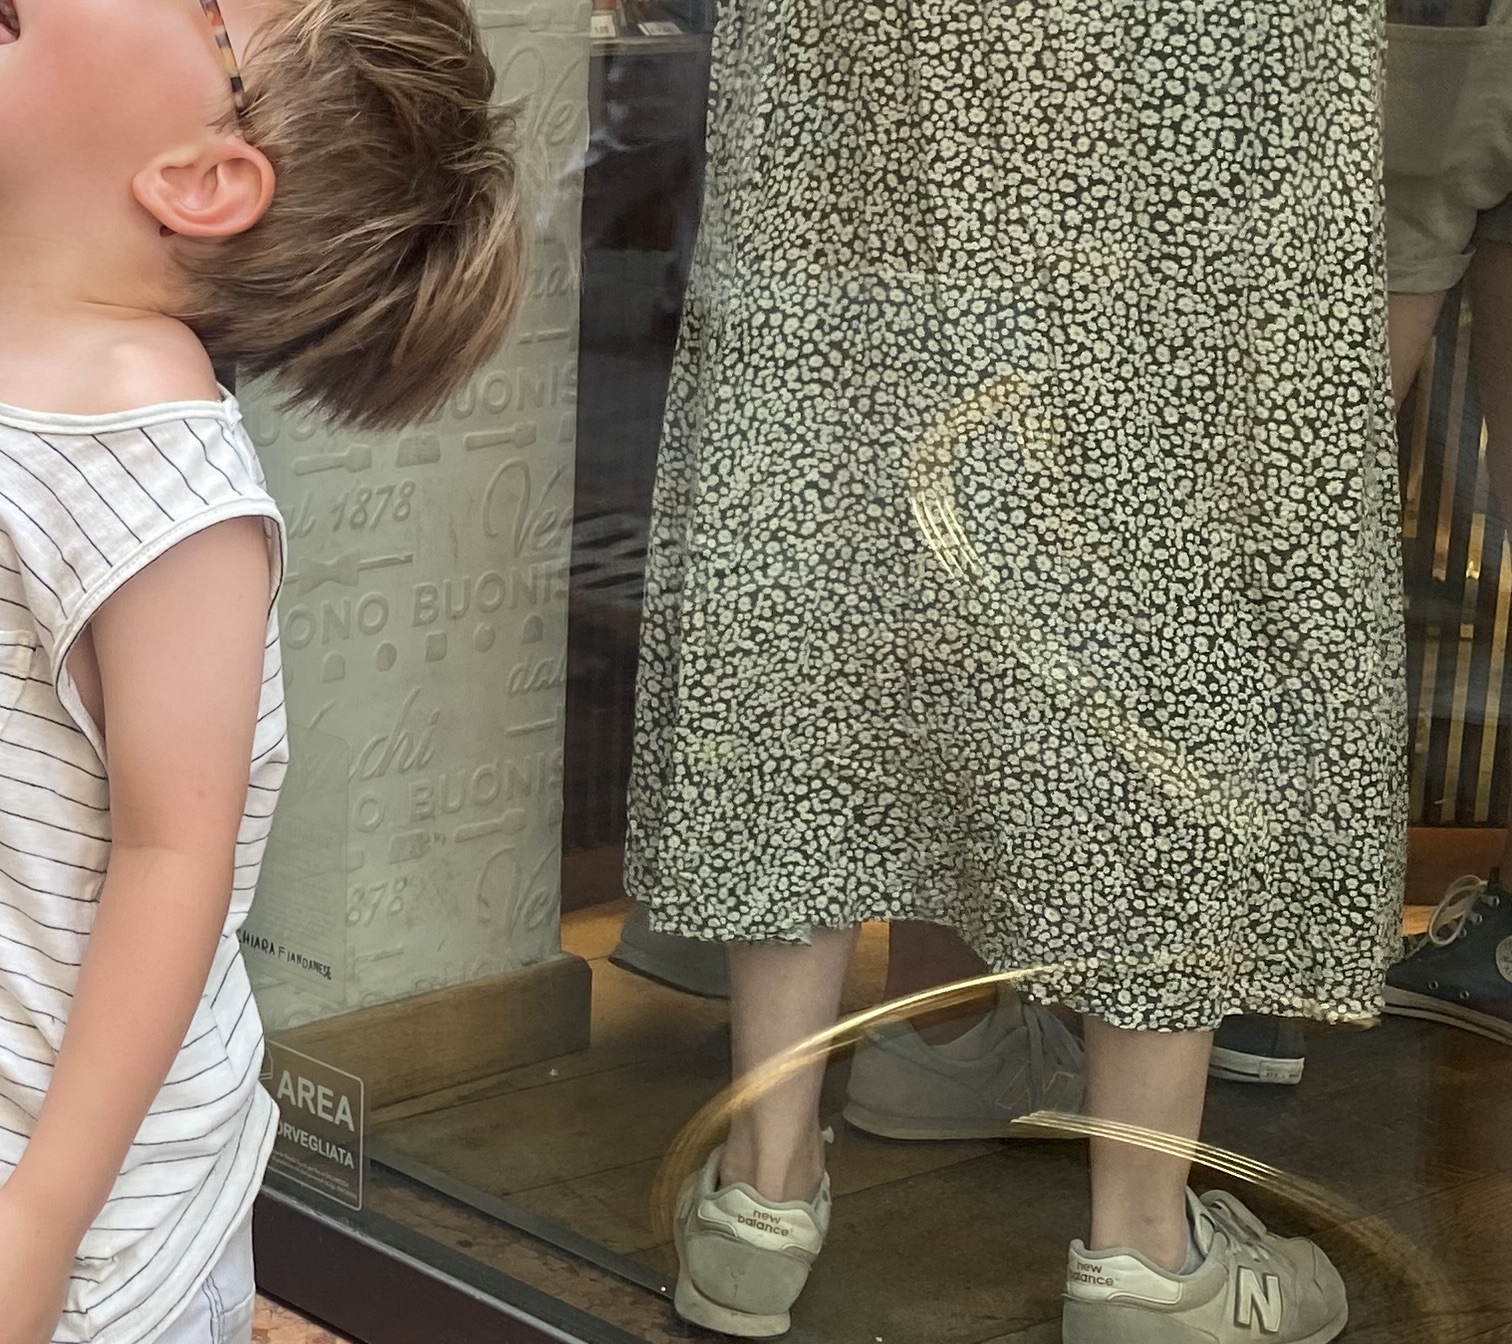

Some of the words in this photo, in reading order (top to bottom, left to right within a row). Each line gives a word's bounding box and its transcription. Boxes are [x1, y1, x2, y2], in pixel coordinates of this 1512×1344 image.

[329, 480, 417, 533] 1878
[283, 590, 390, 651] ONO
[346, 874, 409, 928] 878
[276, 1069, 355, 1132] AREA
[277, 1120, 355, 1170] ORVEGLIATA
[737, 1213, 790, 1237] balance
[753, 1209, 782, 1225] new
[1076, 1260, 1103, 1274] new
[1234, 1265, 1283, 1335] N
